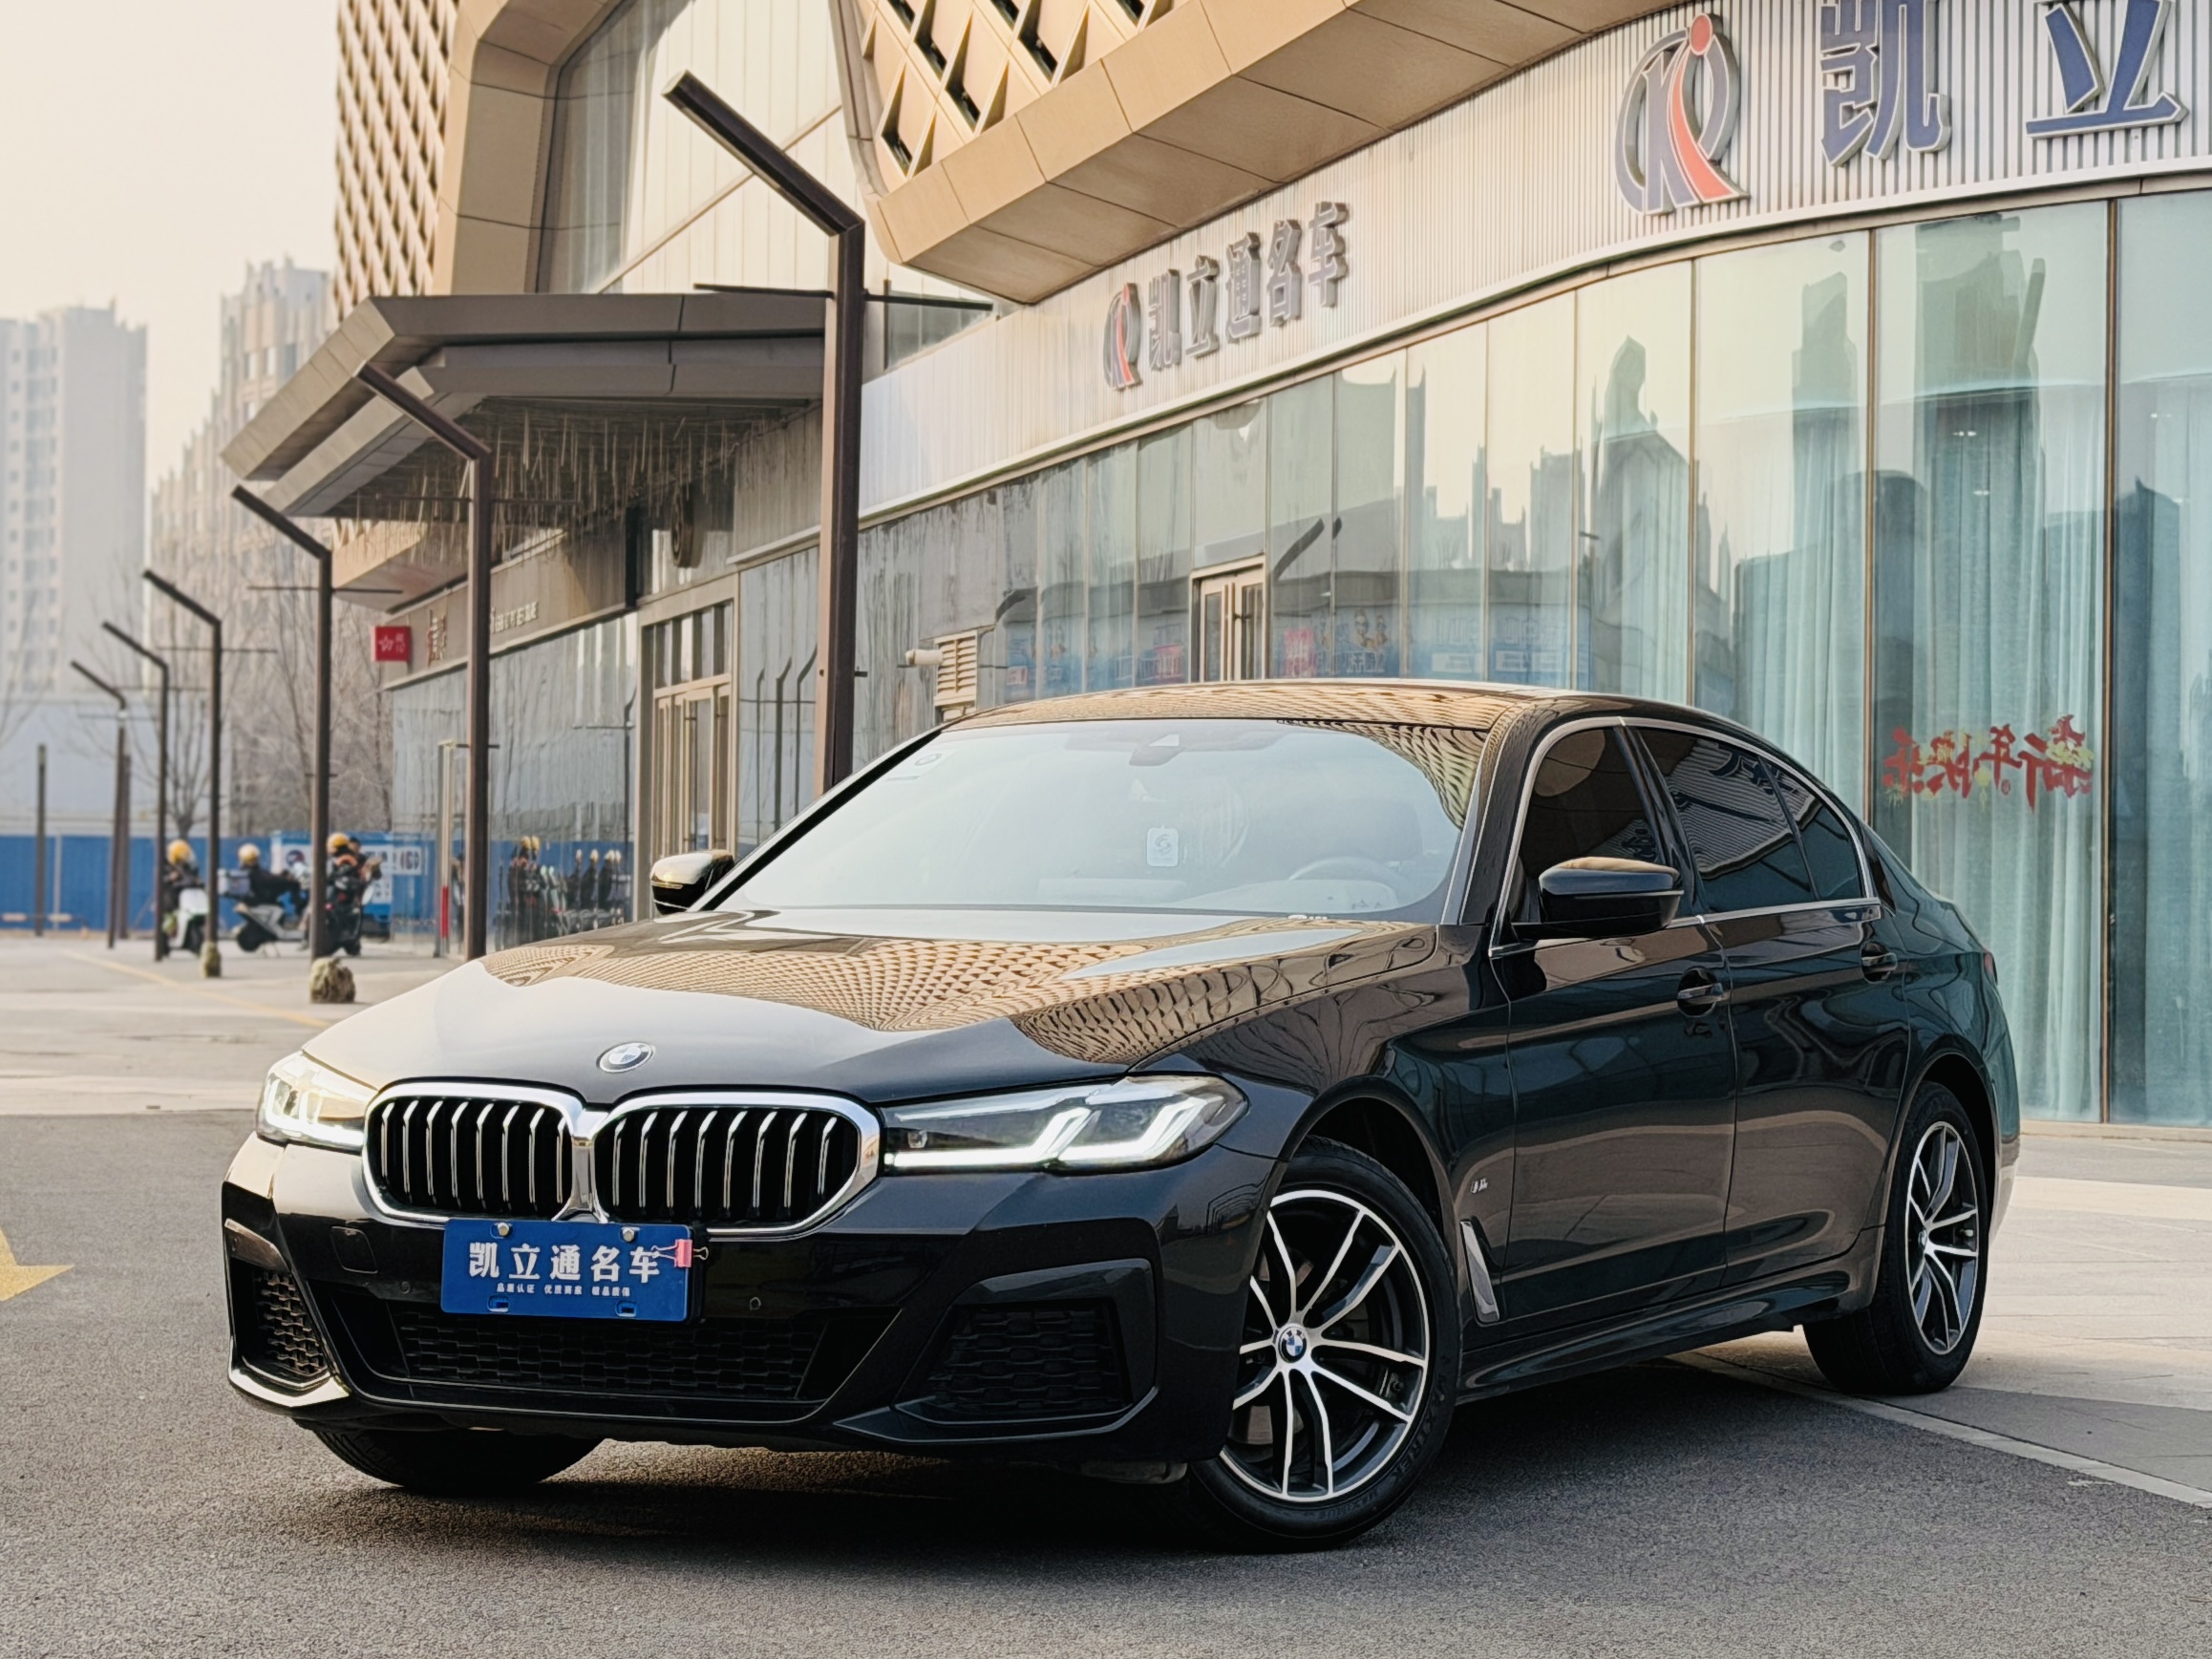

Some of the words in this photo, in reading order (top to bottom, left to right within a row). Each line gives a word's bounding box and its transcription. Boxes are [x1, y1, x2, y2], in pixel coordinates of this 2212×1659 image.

[1819, 0, 2188, 166] 凯立
[1148, 201, 1349, 372] 凯立通名车
[469, 1242, 660, 1283] 凯立通名车
[1389, 1372, 1447, 1486] MAXTREK
